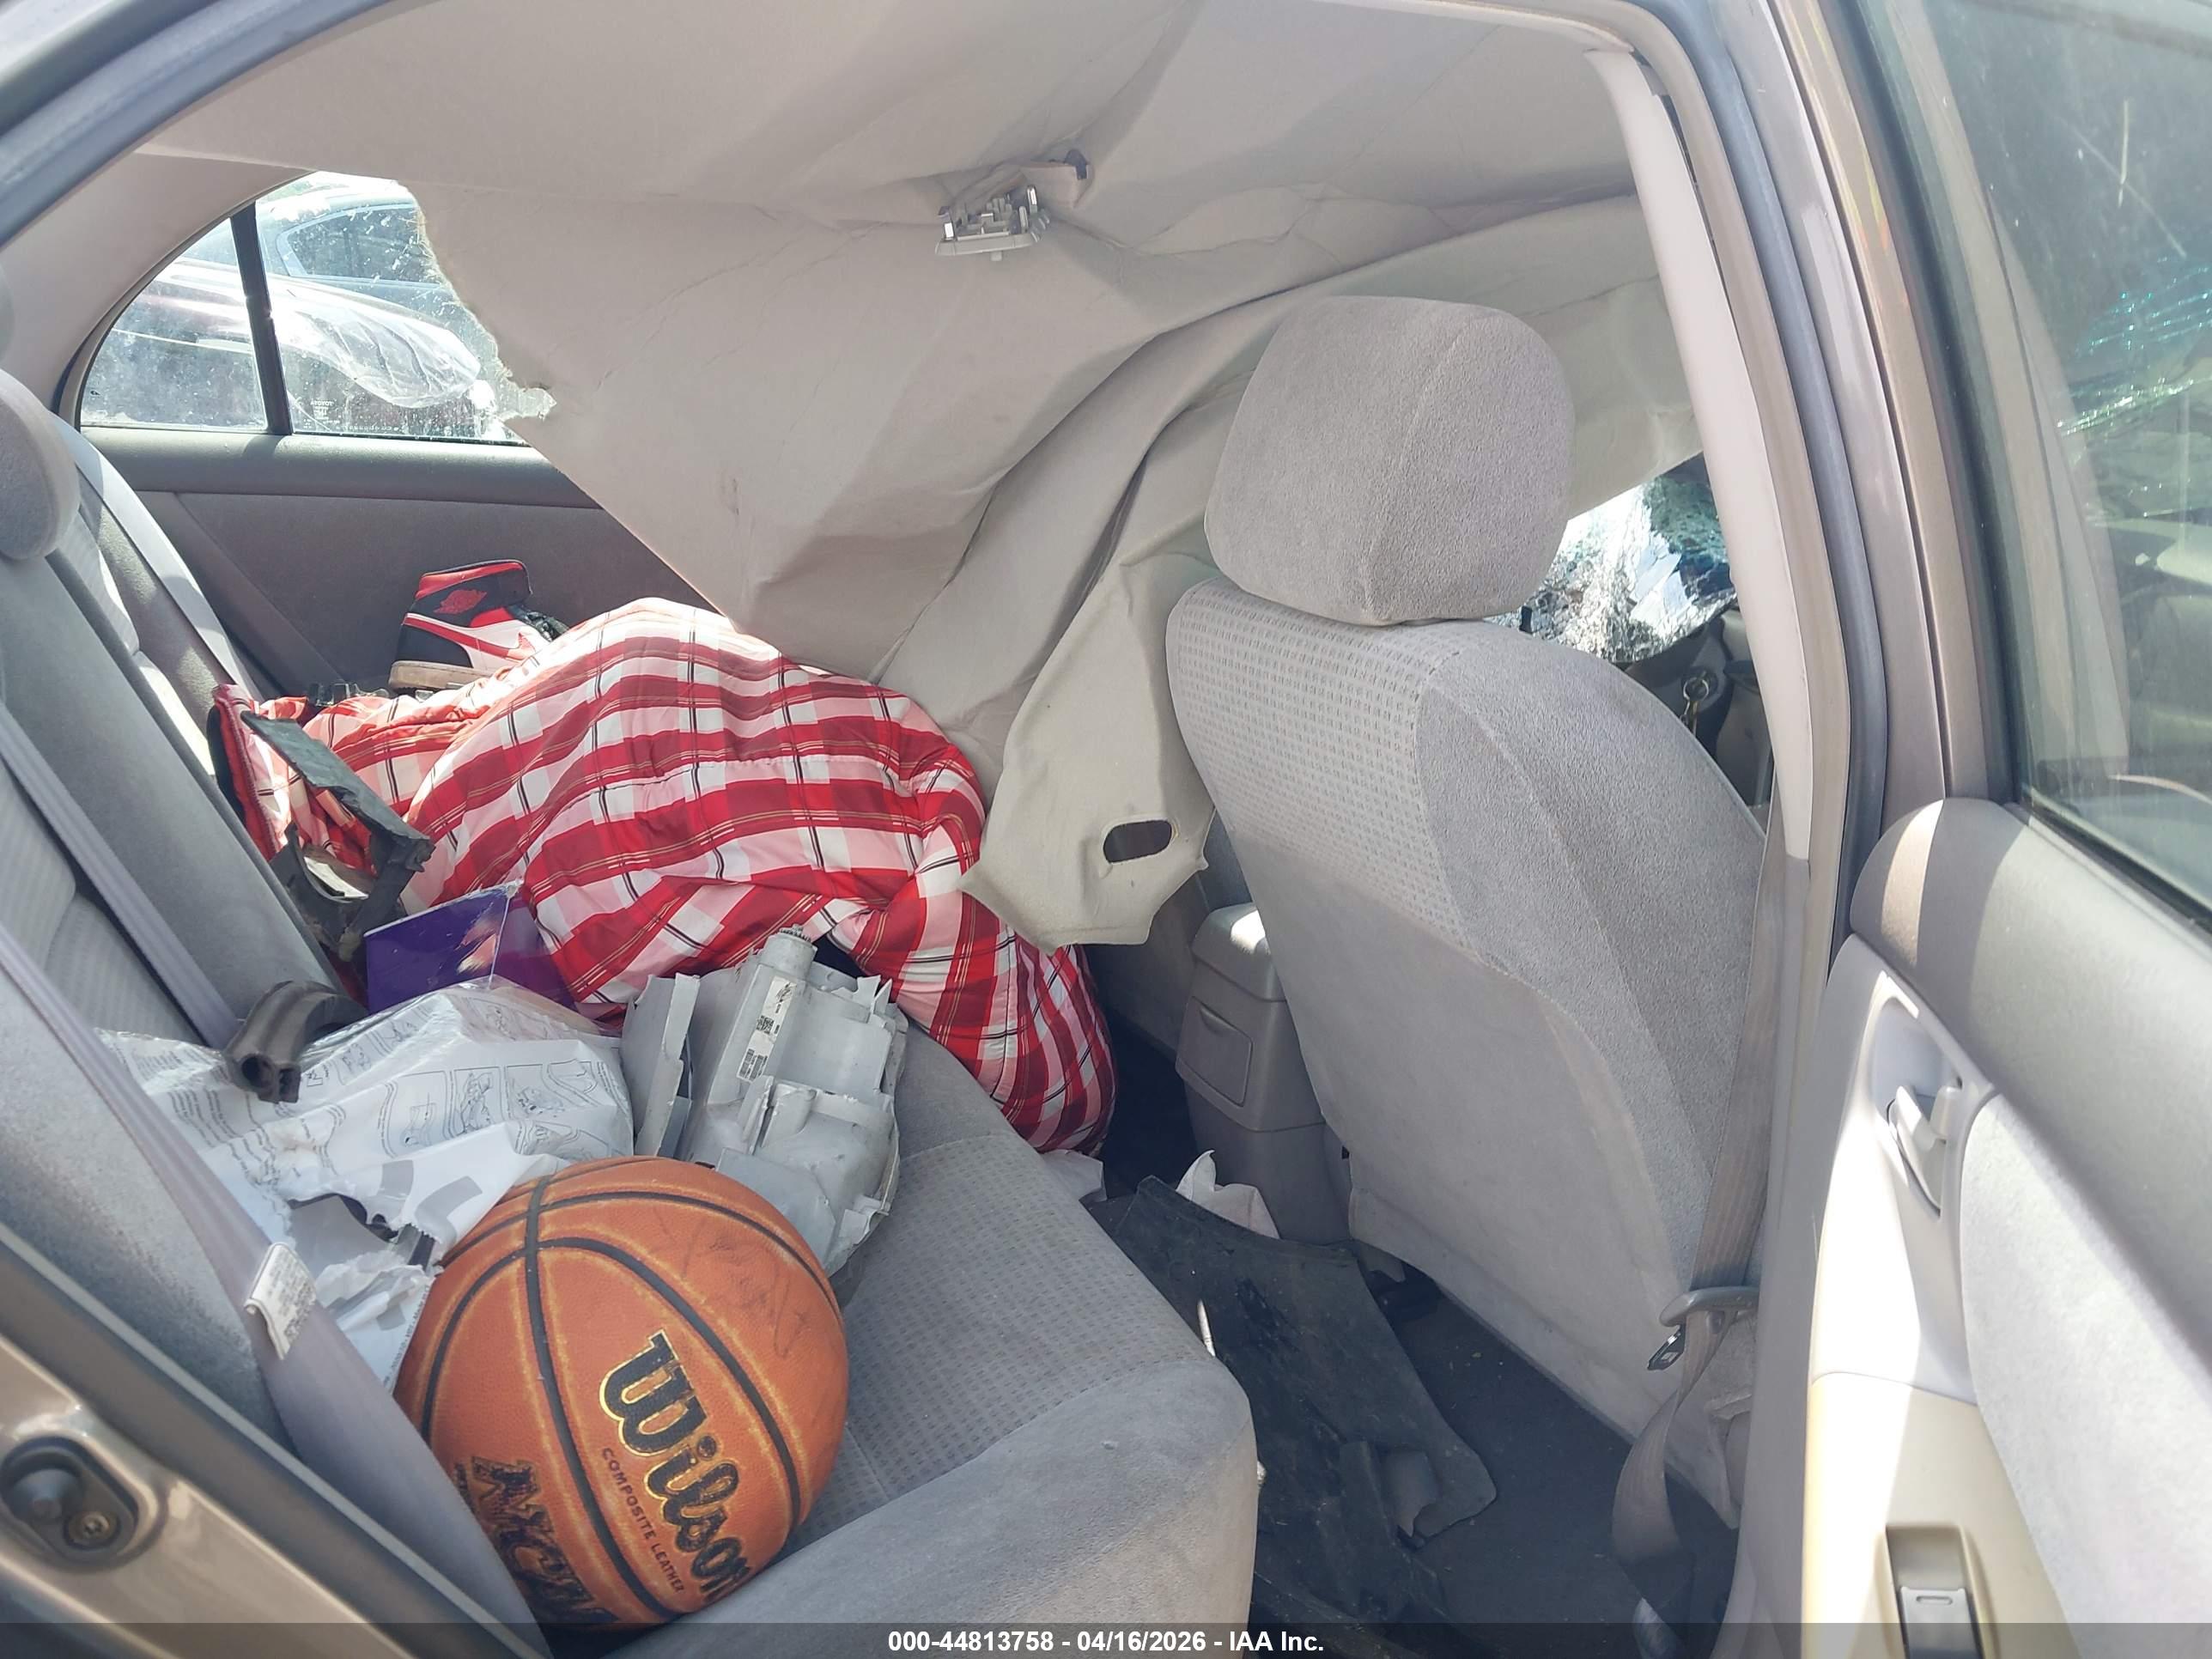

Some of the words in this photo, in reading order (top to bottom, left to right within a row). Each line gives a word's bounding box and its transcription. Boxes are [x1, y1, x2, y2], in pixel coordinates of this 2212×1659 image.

[599, 1329, 750, 1601] Wilson
[602, 1448, 656, 1538] COMPOSITE
[651, 1542, 685, 1594] LEATHER
